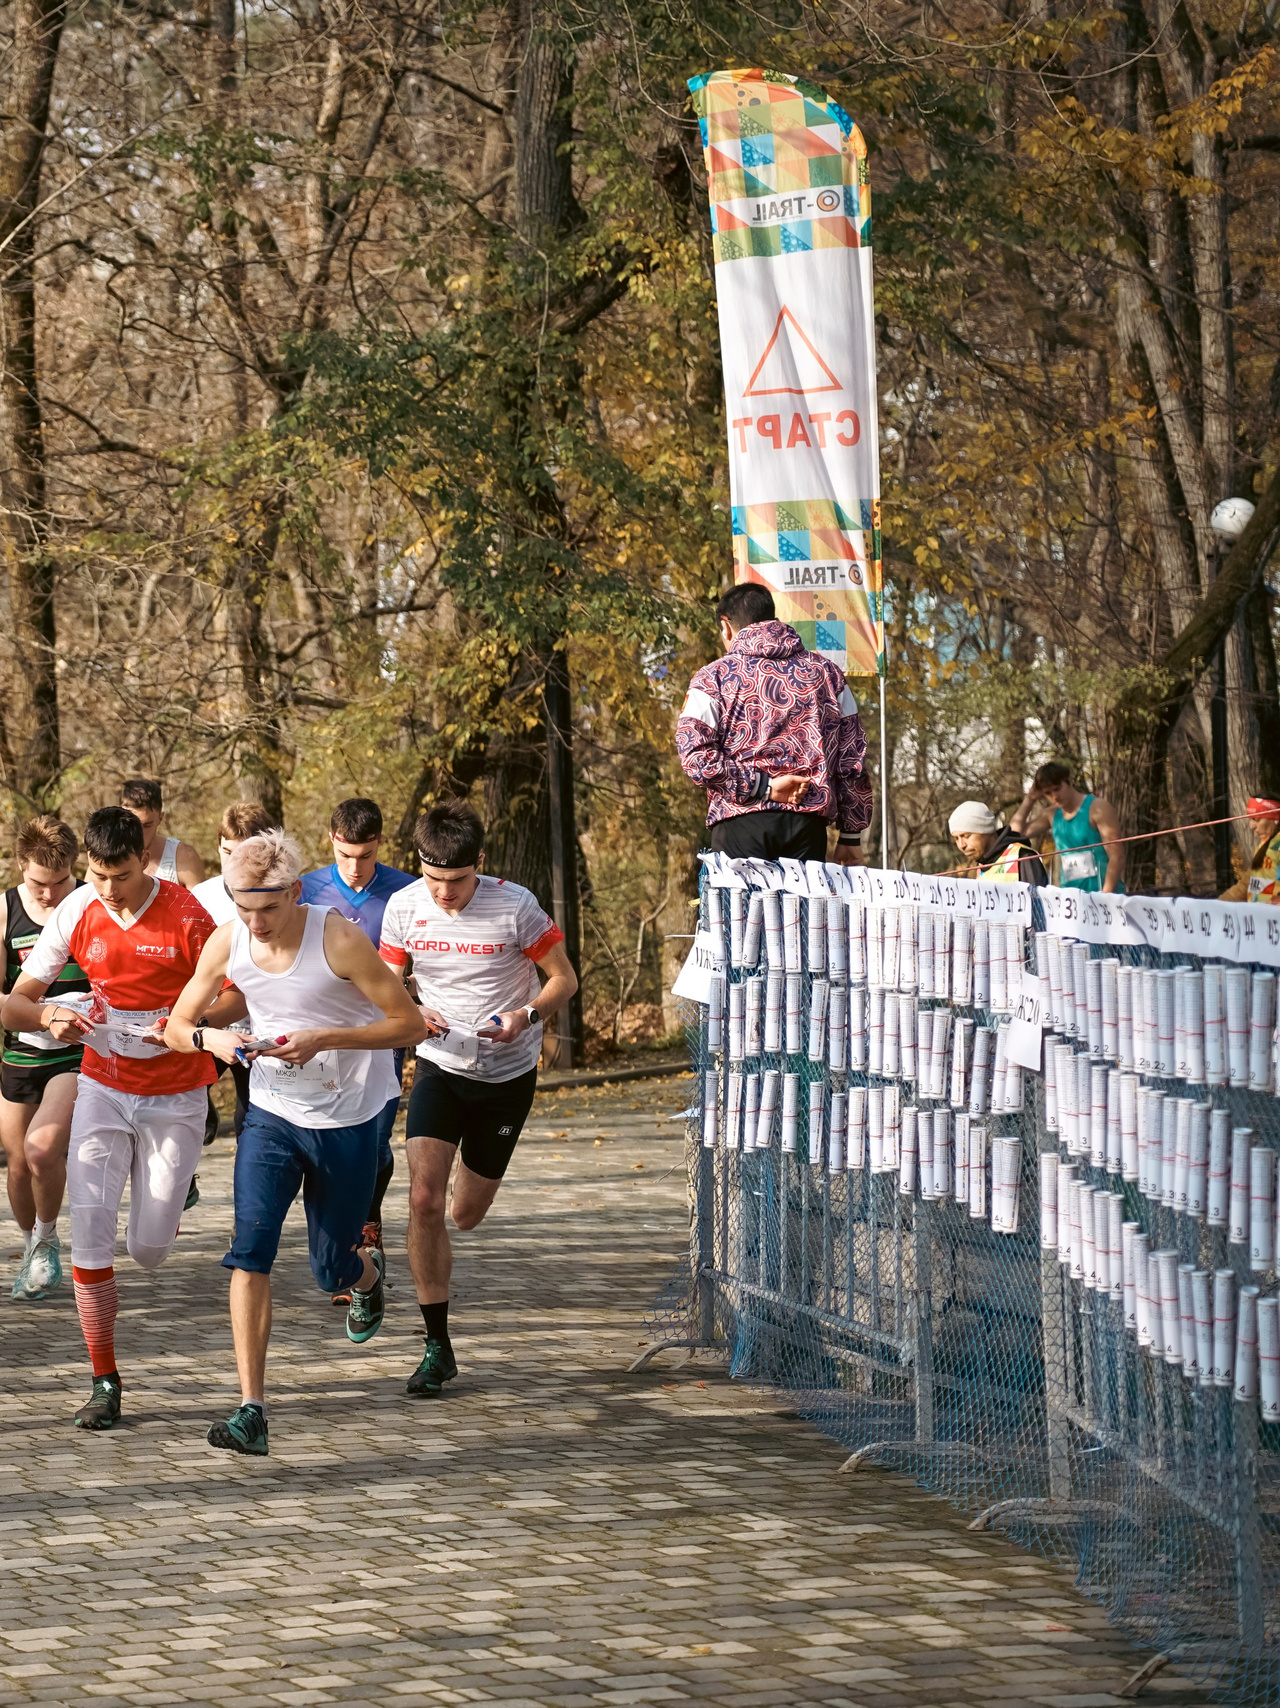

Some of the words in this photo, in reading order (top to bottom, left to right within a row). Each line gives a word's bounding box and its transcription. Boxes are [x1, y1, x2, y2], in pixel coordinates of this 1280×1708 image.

[858, 875, 865, 893] 8
[877, 878, 883, 896] 9
[893, 880, 905, 898] 10
[945, 886, 956, 906] 13
[966, 889, 976, 909] 14
[985, 890, 995, 910] 15
[136, 944, 164, 953] МГТУ
[405, 940, 451, 952] NORD
[455, 942, 507, 955] WEST
[319, 1062, 324, 1072] 1
[275, 1069, 297, 1078] МЖ20
